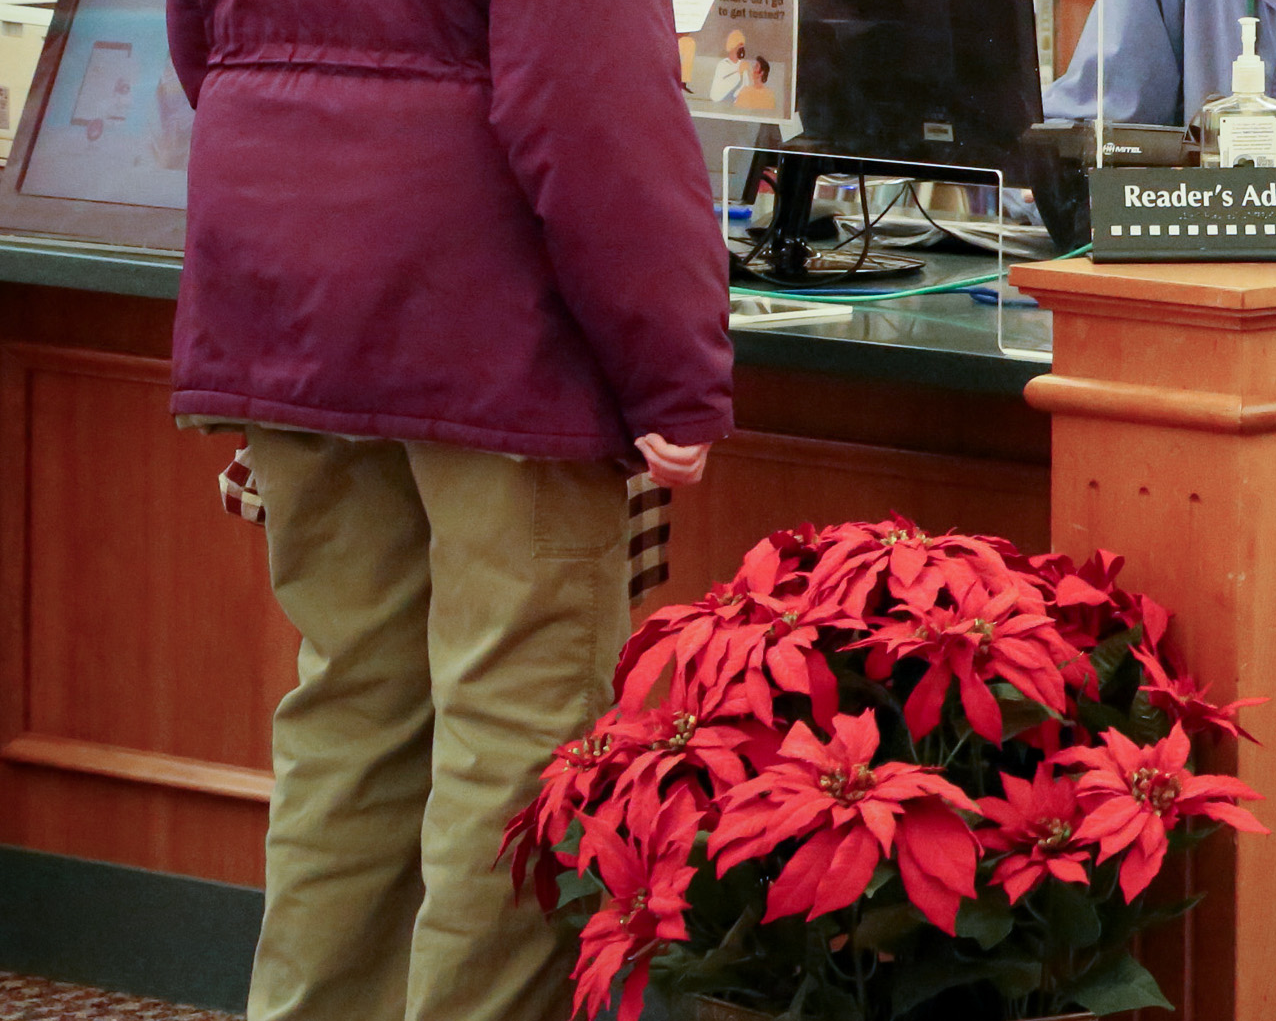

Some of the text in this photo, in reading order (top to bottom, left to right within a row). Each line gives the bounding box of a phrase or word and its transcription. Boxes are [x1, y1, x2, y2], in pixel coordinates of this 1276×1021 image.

[718, 6, 786, 20] to get tested?
[1115, 146, 1143, 154] MITEL
[1124, 183, 1233, 208] Reader's
